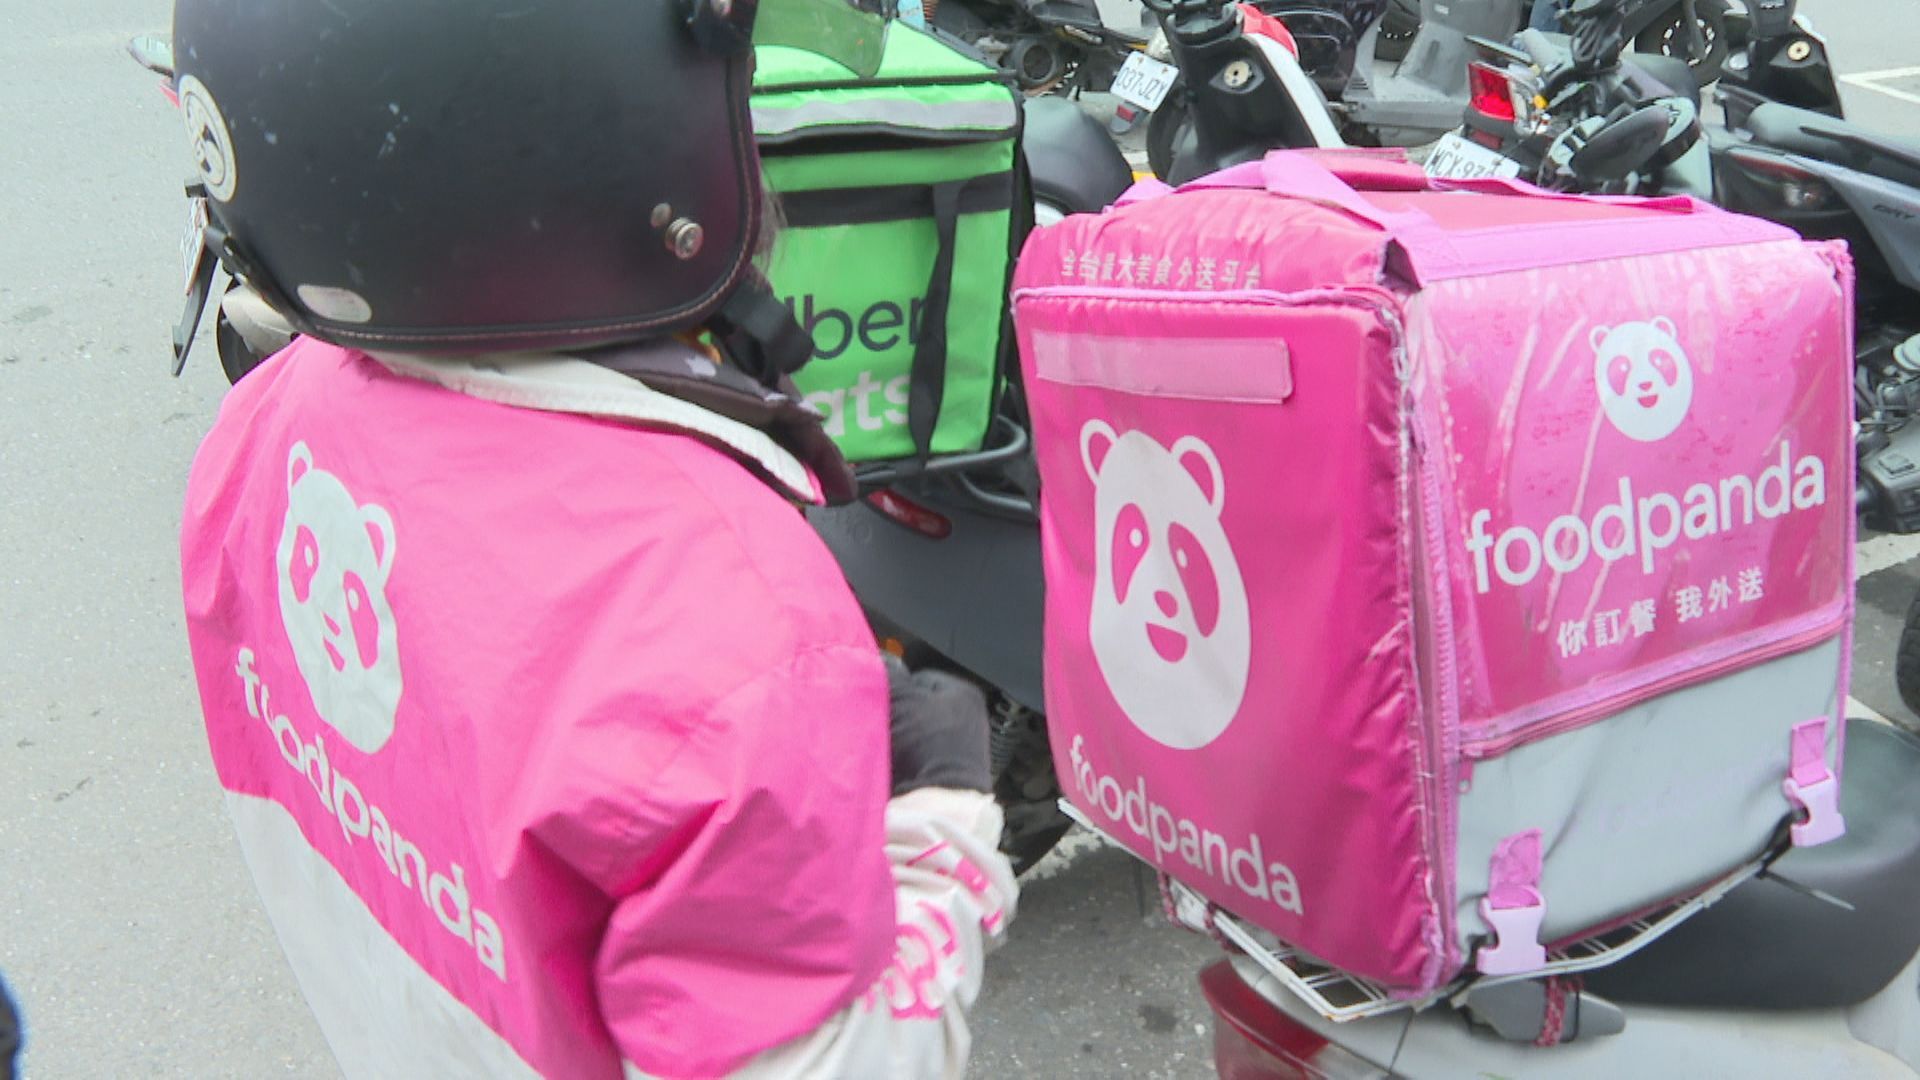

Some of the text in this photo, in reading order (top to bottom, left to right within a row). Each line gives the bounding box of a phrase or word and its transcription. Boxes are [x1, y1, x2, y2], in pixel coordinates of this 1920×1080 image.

[800, 369, 912, 437] ats
[1465, 439, 1826, 594] foodpanda
[1557, 567, 1765, 658] 你訂餐 我外送
[1069, 734, 1305, 916] foodpanda
